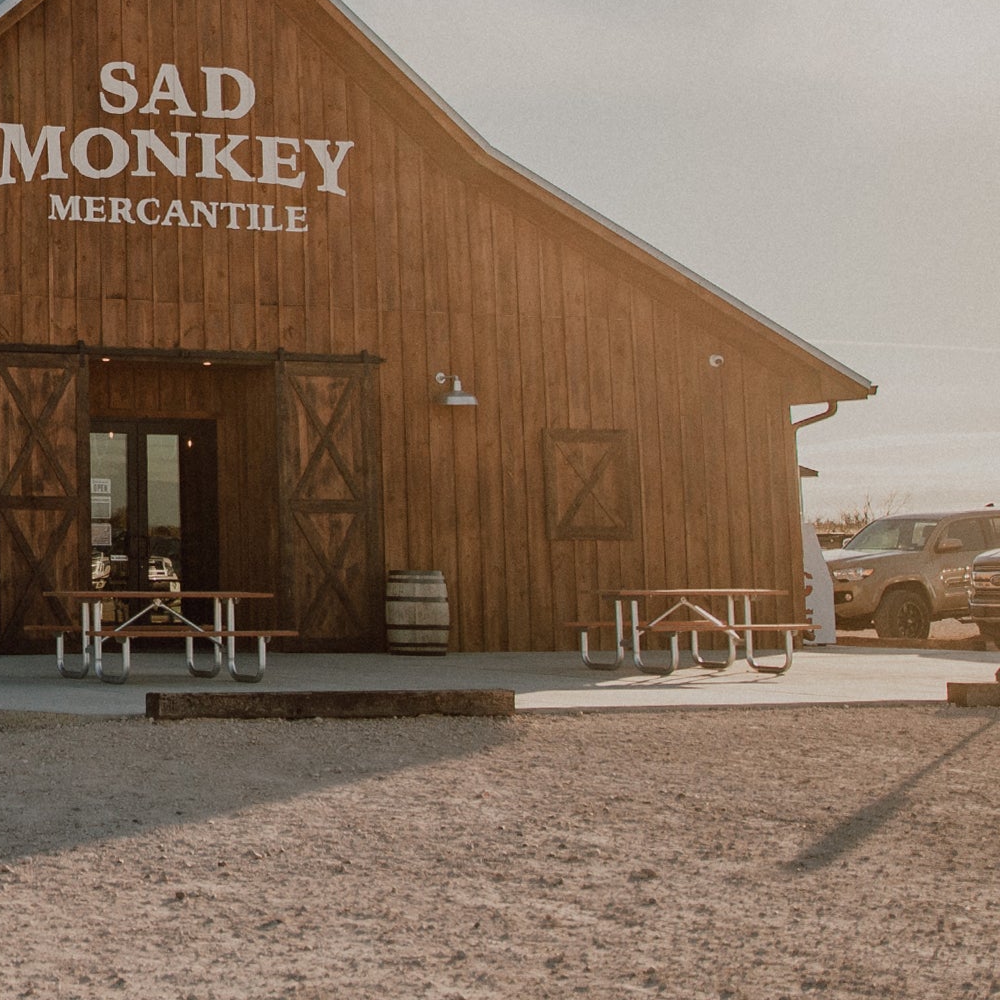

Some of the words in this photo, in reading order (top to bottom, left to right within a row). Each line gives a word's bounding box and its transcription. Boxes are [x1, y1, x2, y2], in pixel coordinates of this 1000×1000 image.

[99, 61, 256, 120] SAD
[48, 193, 309, 233] MERCANTILE
[93, 483, 108, 492] OPEN
